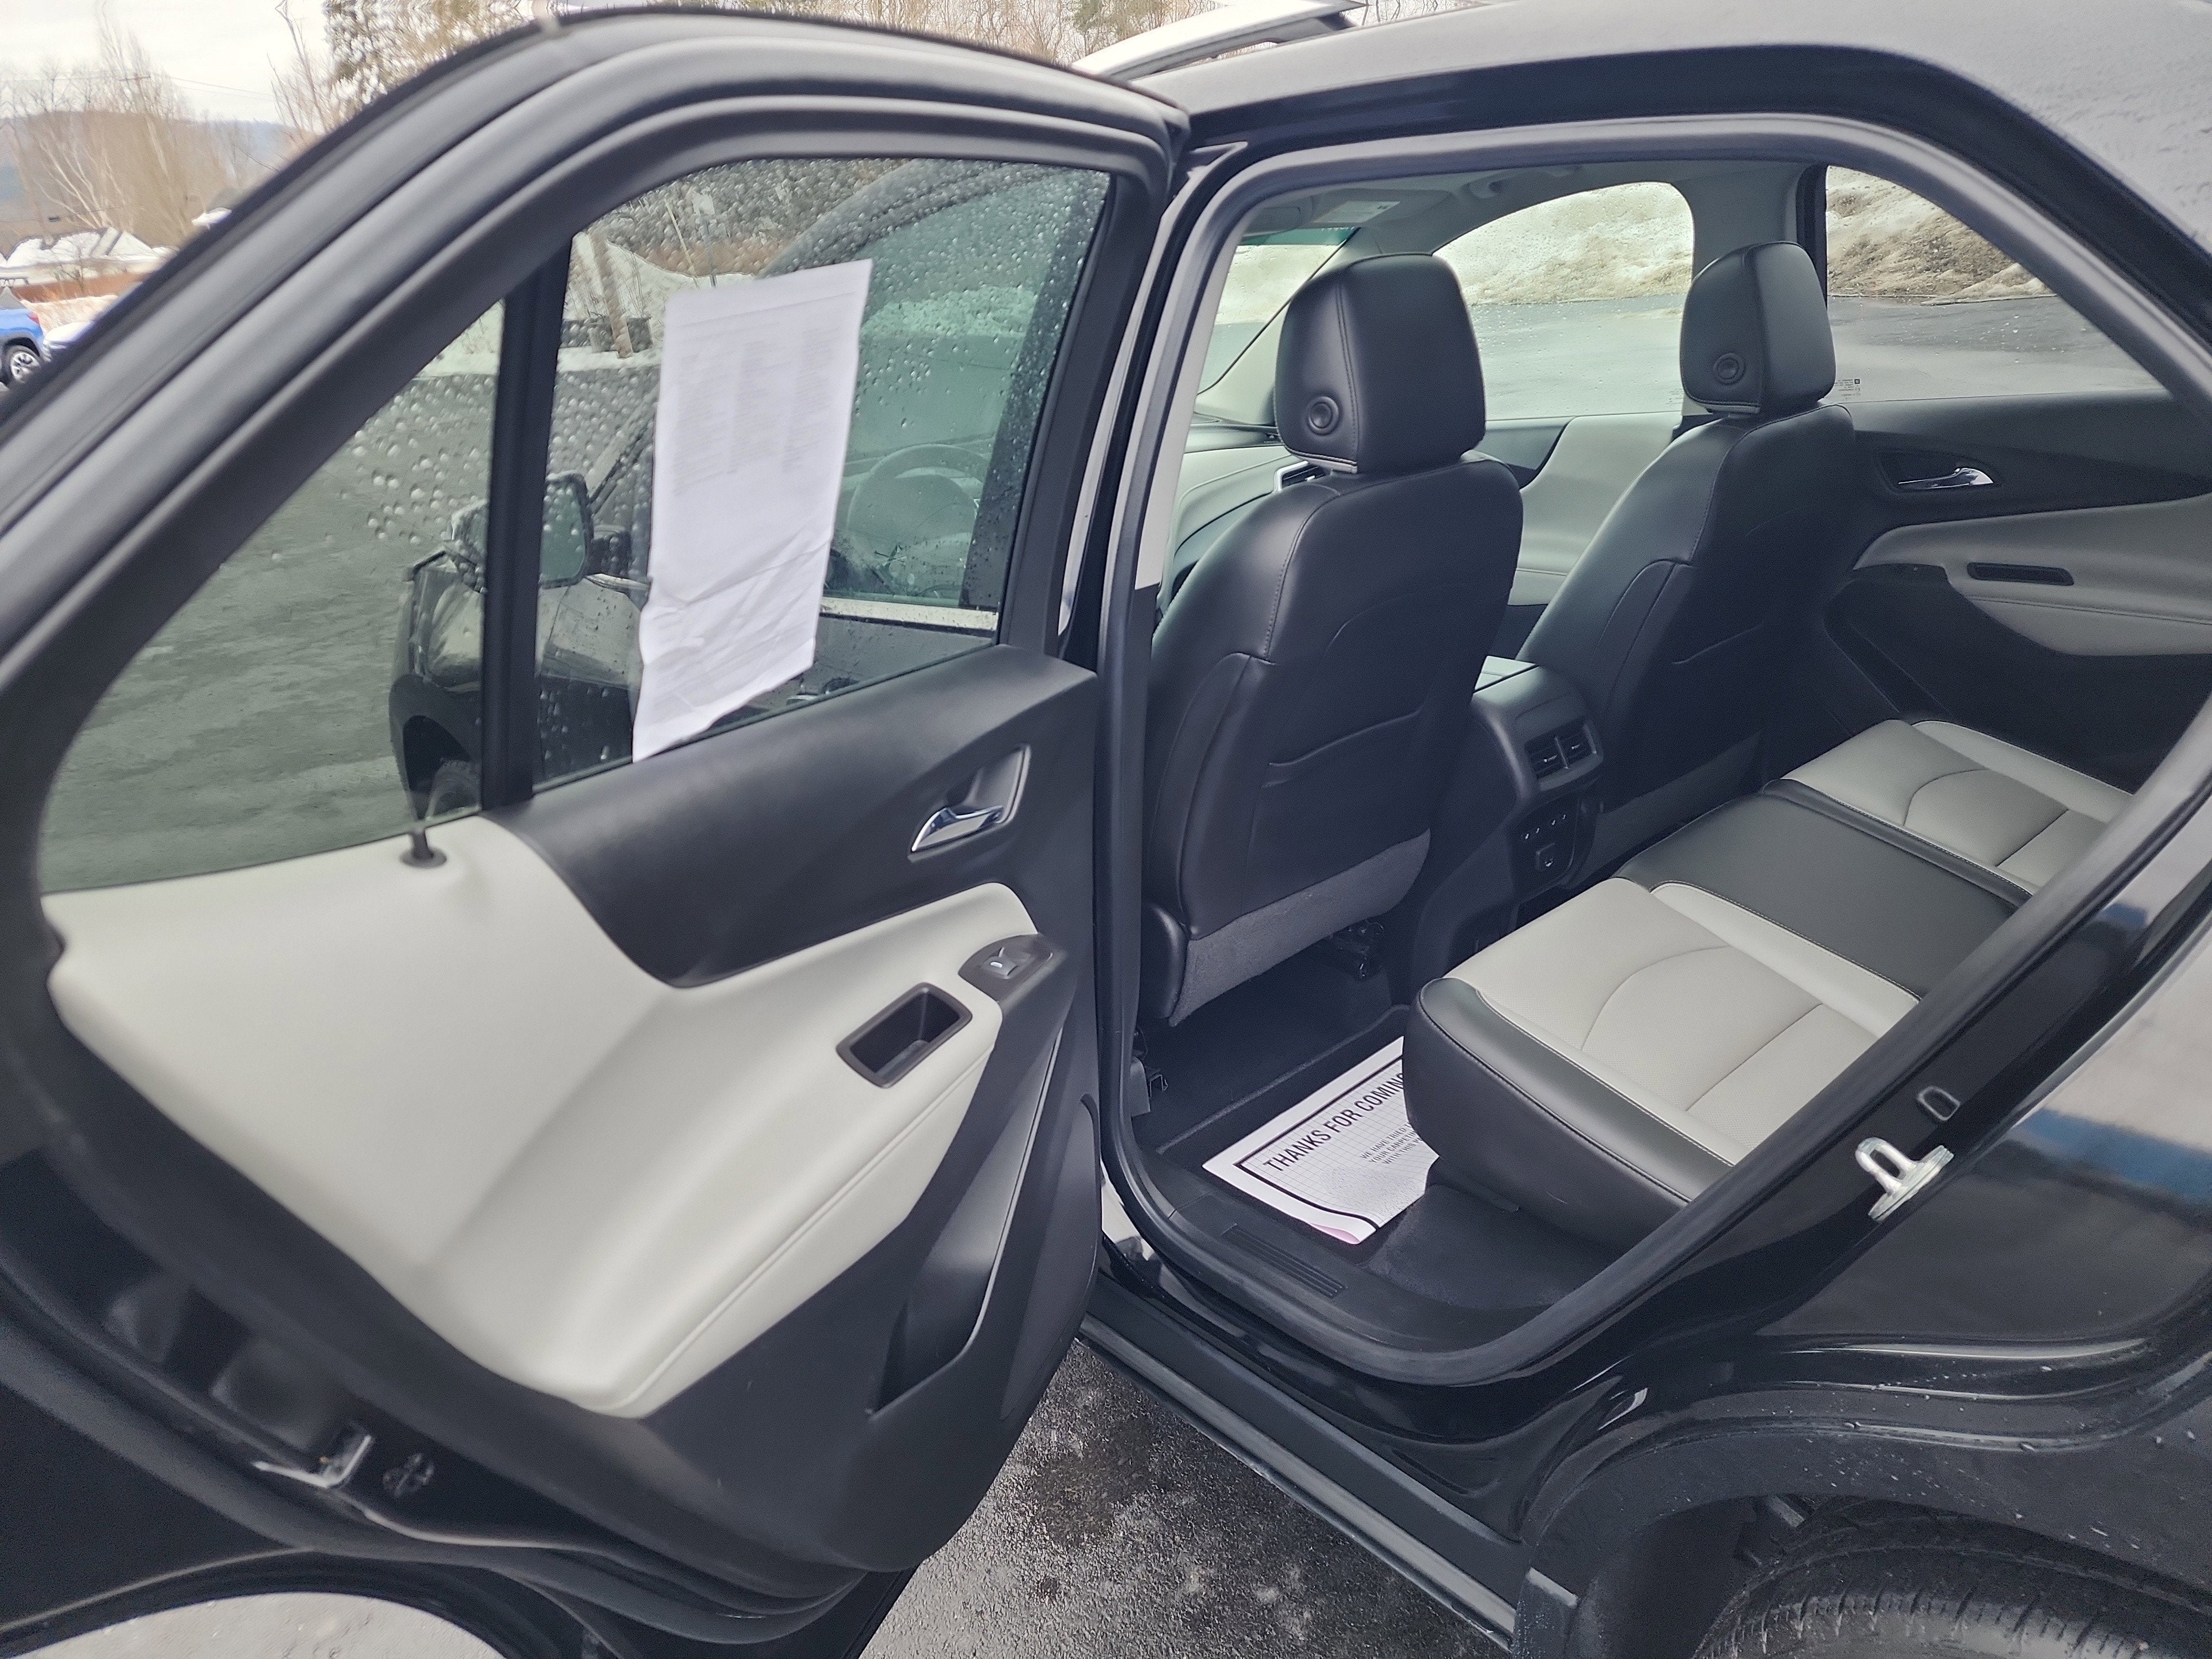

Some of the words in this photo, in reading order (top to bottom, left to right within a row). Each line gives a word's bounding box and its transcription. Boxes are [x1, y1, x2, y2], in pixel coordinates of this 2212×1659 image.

[1262, 1129, 1331, 1171] THANKS
[1323, 1109, 1363, 1133] FOR
[1359, 1151, 1373, 1159] WE
[1370, 1139, 1389, 1152] HAVE
[1386, 1128, 1406, 1140] TRIED
[1382, 1152, 1402, 1164] WITH
[1399, 1142, 1416, 1153] THIS
[1369, 1151, 1390, 1163] YOUR
